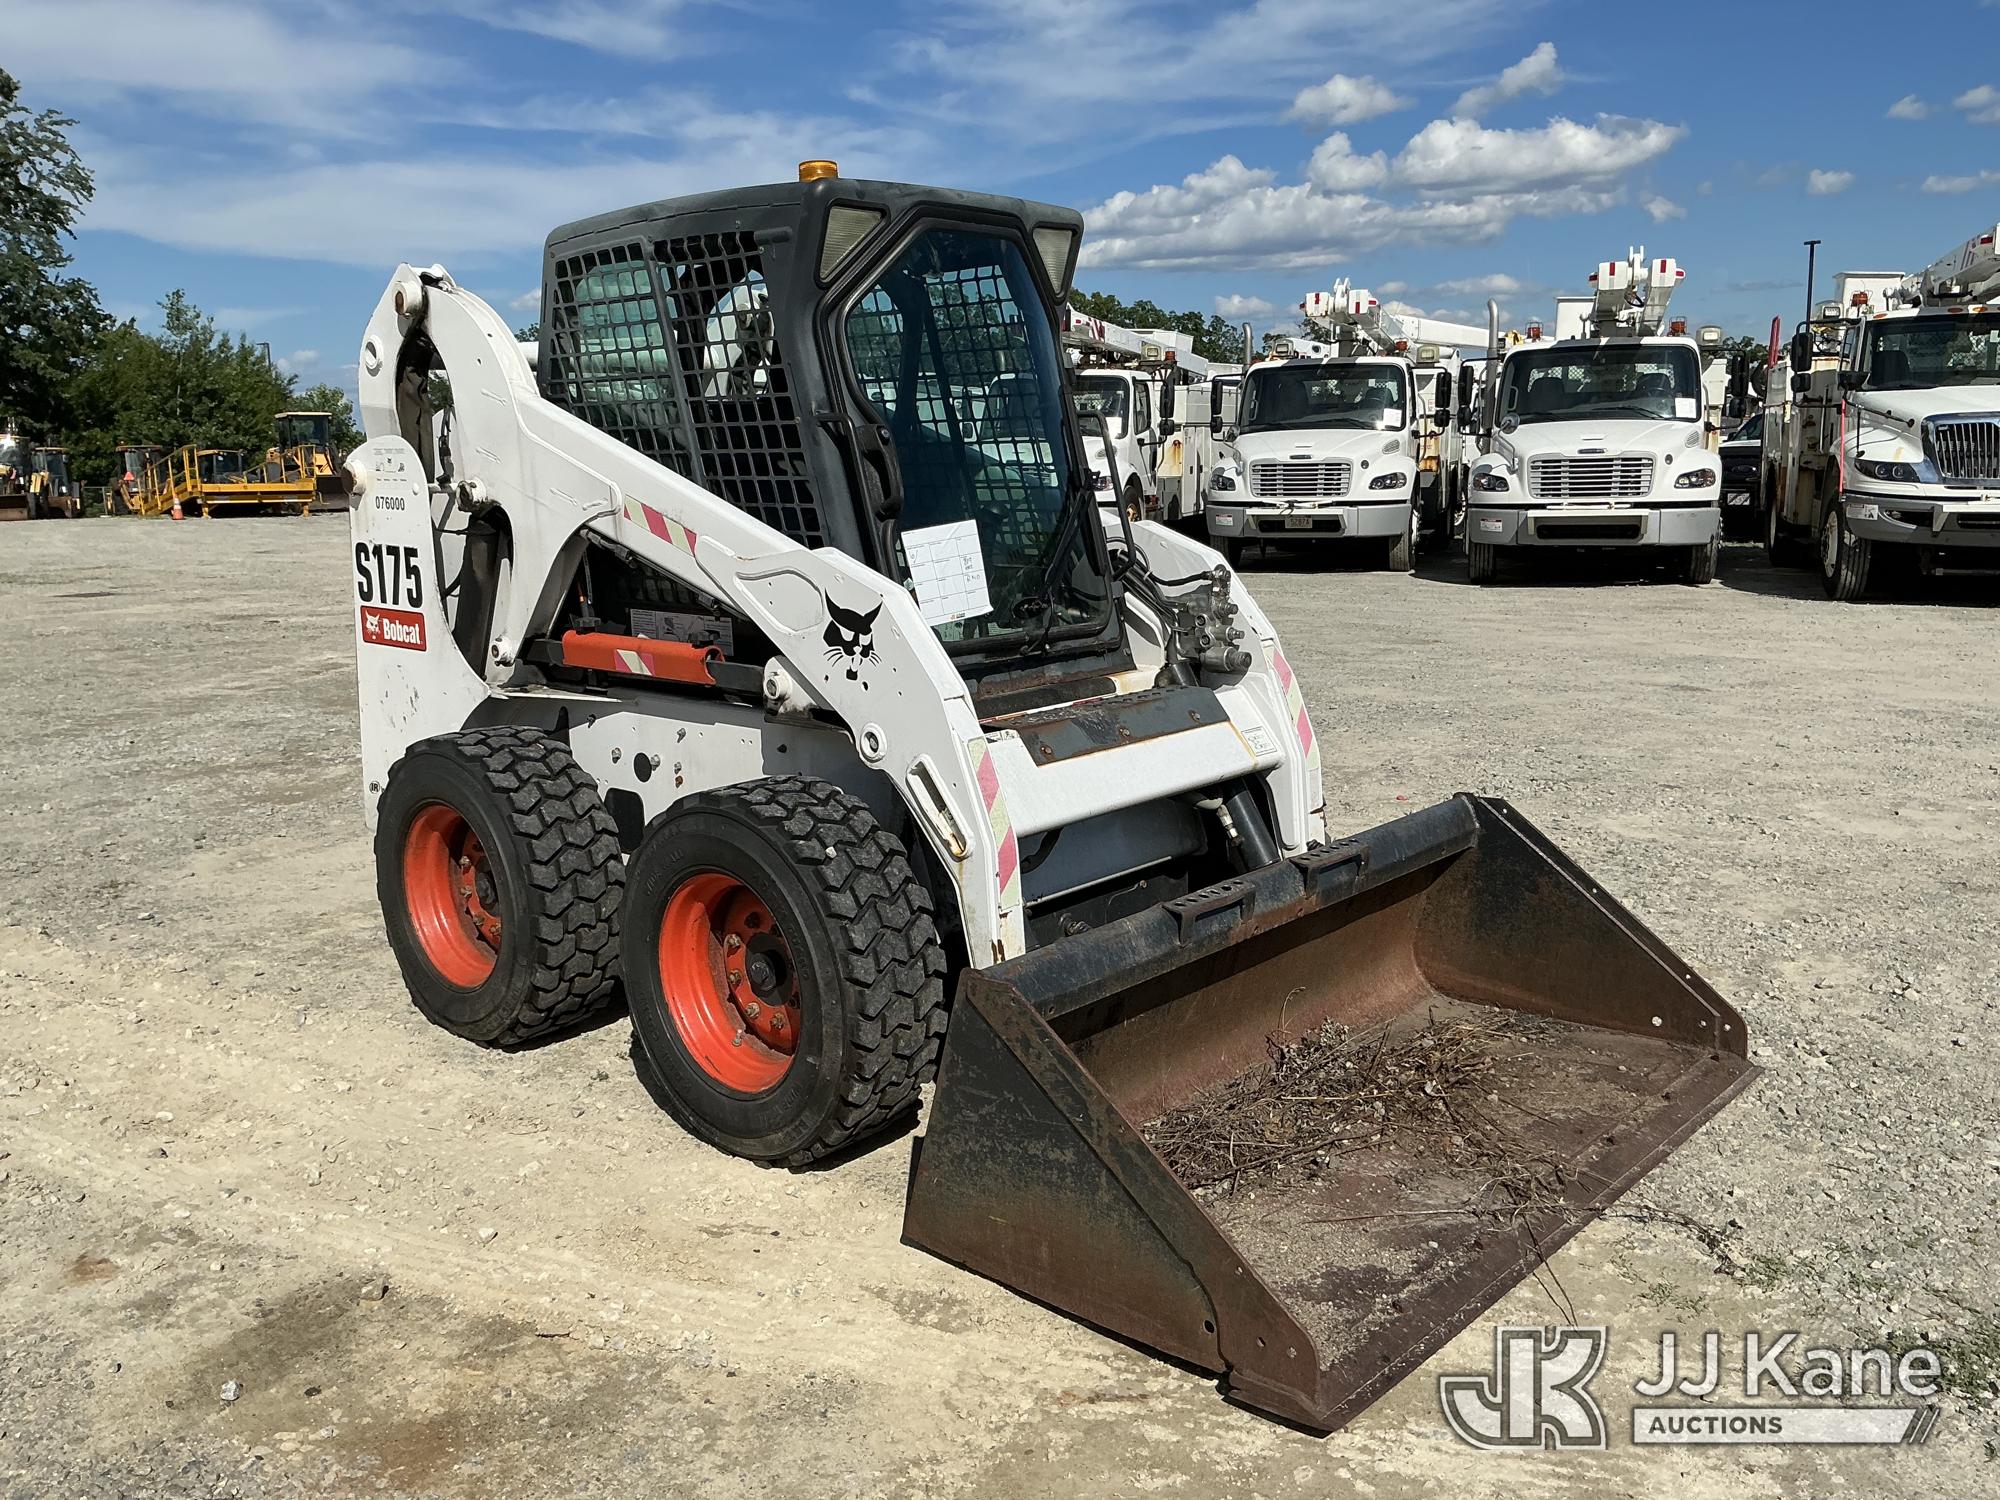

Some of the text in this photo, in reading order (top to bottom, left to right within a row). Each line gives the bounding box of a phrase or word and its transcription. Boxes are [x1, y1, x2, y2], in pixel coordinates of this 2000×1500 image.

[375, 495, 406, 511] 076000
[355, 541, 424, 609] S175
[382, 617, 422, 645] Bobcat
